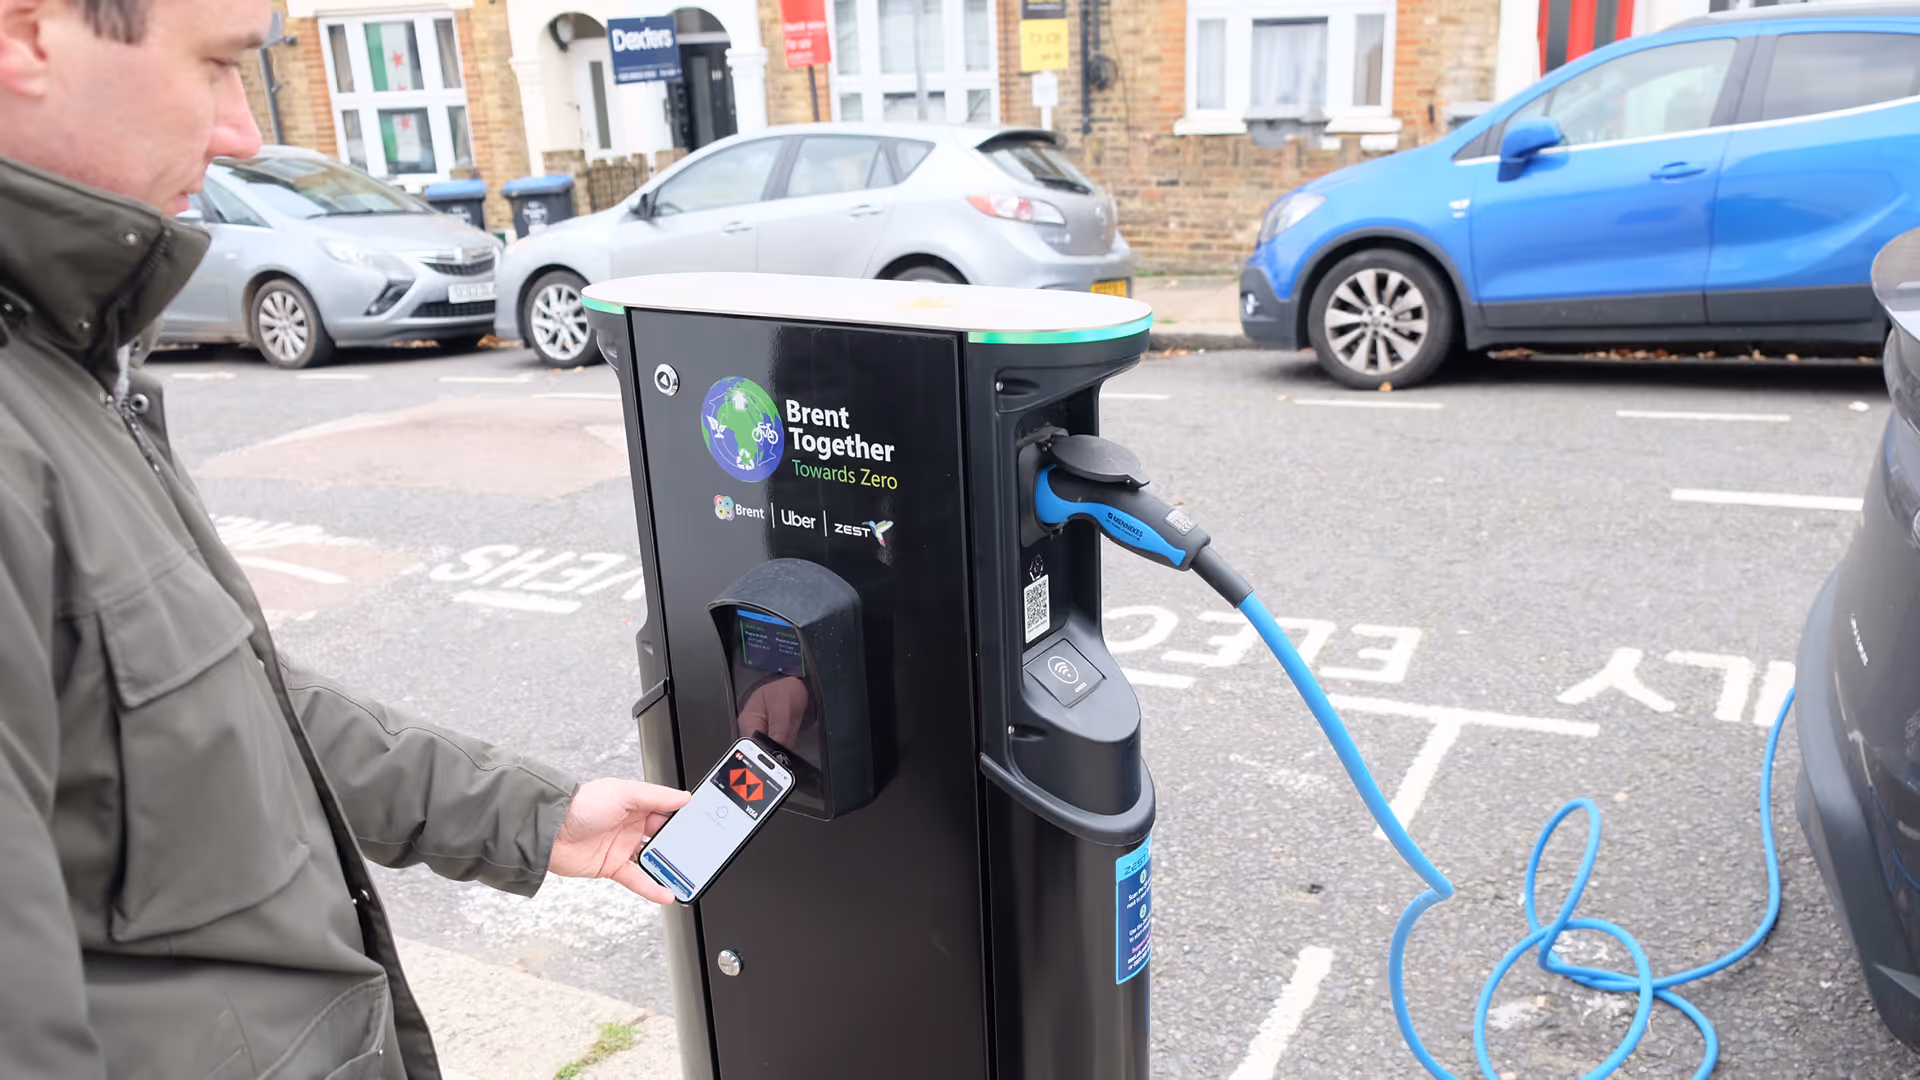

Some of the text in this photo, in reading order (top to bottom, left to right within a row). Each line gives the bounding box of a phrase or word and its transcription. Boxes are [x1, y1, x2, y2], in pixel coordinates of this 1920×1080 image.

[612, 27, 674, 52] Dexters
[786, 399, 850, 429] Brent
[788, 427, 895, 462] Together
[792, 459, 898, 489] Towards Zero
[735, 504, 765, 519] Brent
[781, 509, 816, 529] Uber
[834, 523, 871, 537] ZEST
[1113, 516, 1144, 538] MENNEKES
[745, 804, 759, 819] VISA
[1124, 853, 1147, 875] ZEST
